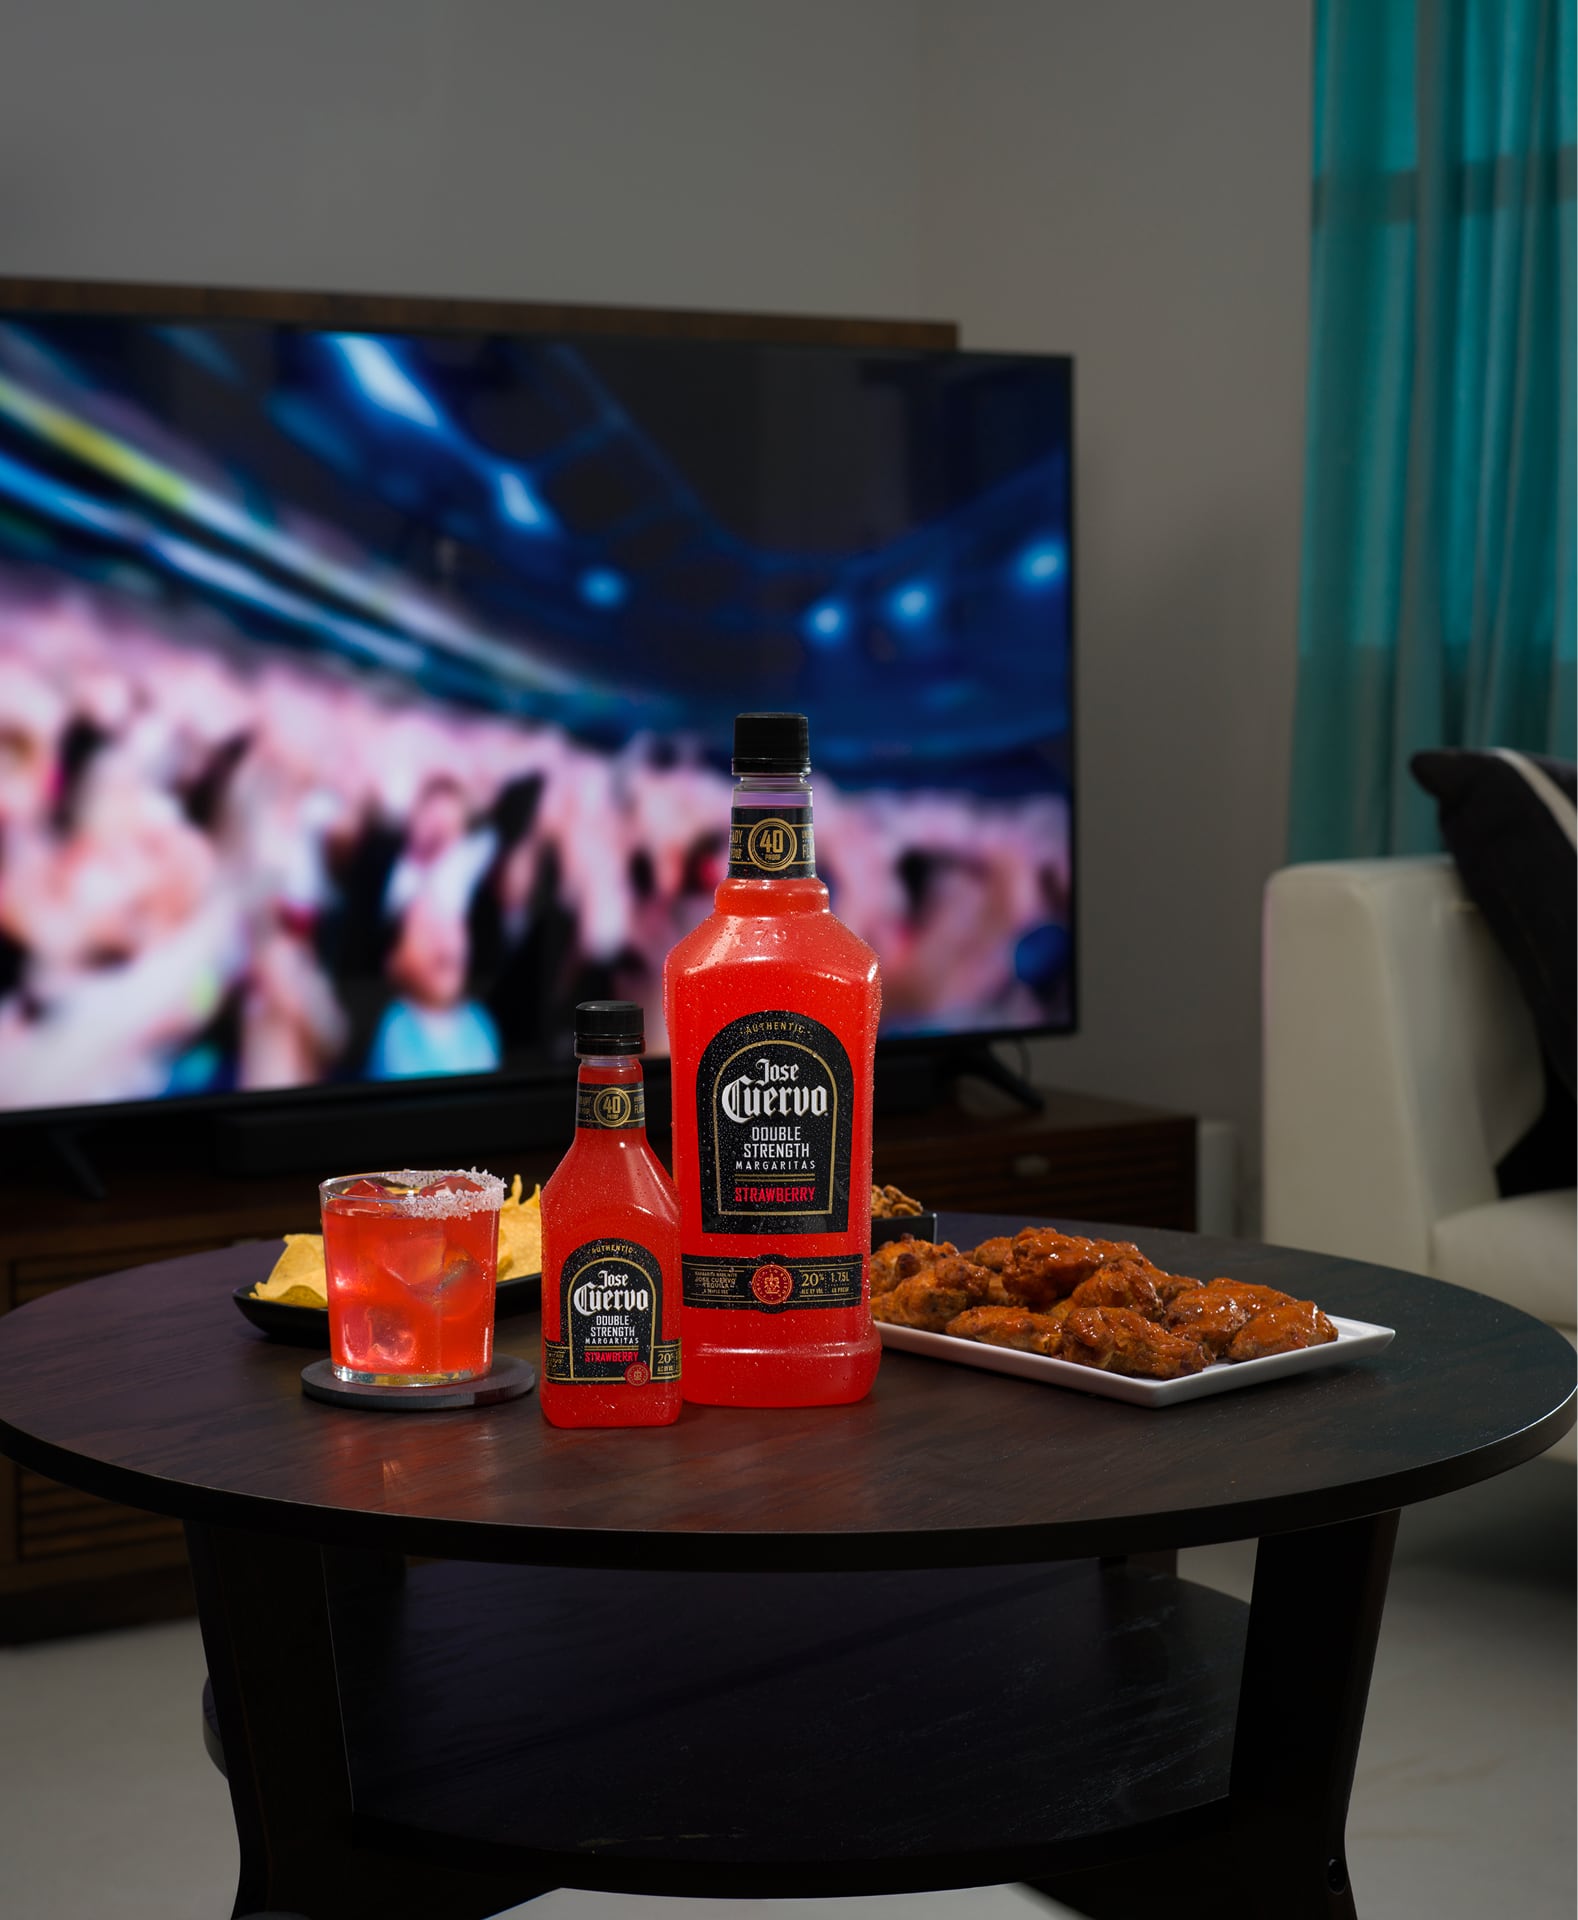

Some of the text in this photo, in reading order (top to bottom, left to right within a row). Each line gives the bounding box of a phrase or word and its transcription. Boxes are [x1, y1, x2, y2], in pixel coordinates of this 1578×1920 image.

[760, 829, 783, 853] 40
[745, 1021, 806, 1035] AUTHENTIC
[756, 1058, 799, 1085] Jose
[603, 1096, 620, 1114] 40
[721, 1075, 829, 1124] Cuervo
[751, 1126, 801, 1141] DOUBLE
[743, 1143, 810, 1158] STRENGTH
[735, 1160, 816, 1170] MARGARITAS
[735, 1186, 816, 1202] STRAWBERRY
[591, 1244, 633, 1254] AUTHENTIC
[598, 1270, 629, 1289] Jose
[831, 1272, 850, 1283] 1.75L
[573, 1281, 649, 1316] Cuervo
[596, 1315, 630, 1326] DOUBLE
[590, 1326, 635, 1337] STRENGTH
[585, 1337, 640, 1345] MARGARITAS
[584, 1351, 639, 1363] STRAWBERRY
